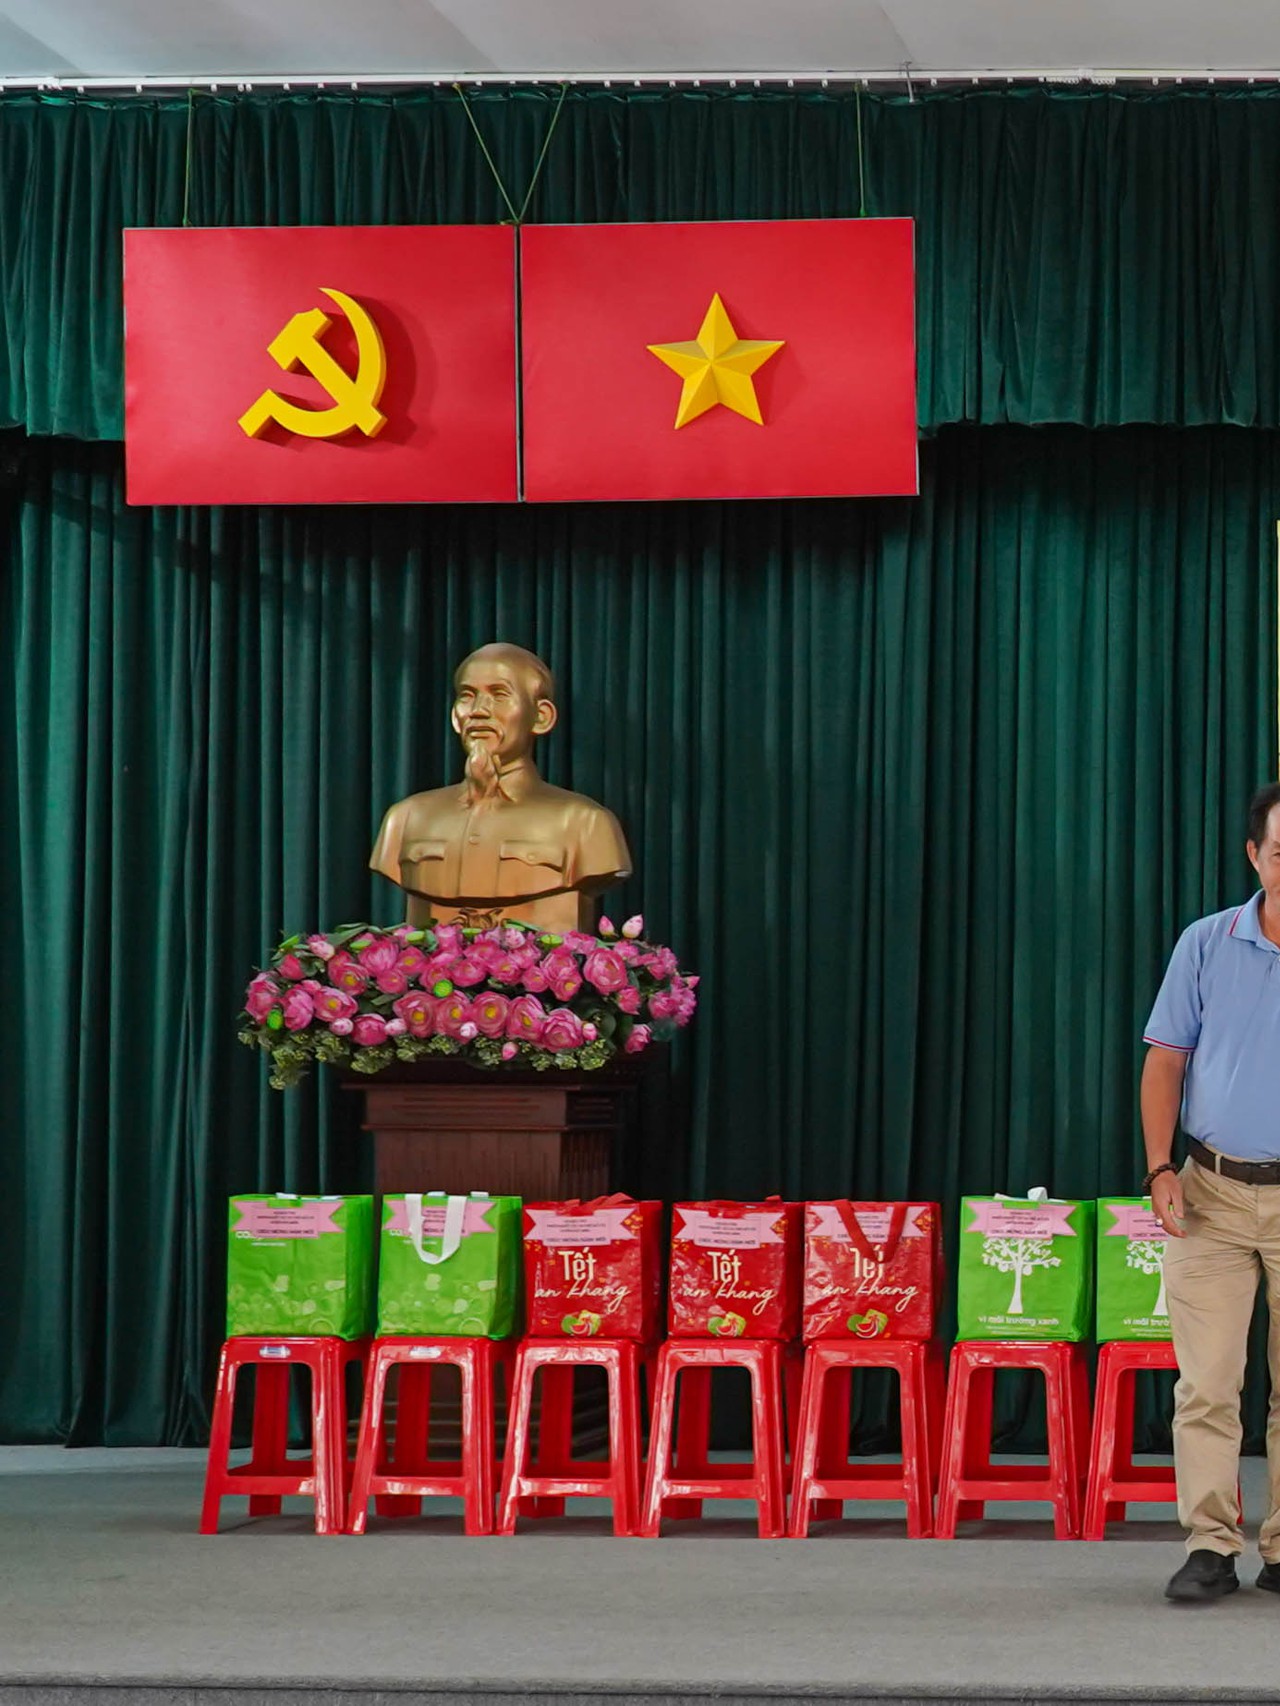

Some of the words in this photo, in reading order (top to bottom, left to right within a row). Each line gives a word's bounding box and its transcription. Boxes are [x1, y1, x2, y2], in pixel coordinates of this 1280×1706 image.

[557, 1246, 597, 1281] Tết
[707, 1249, 742, 1281] Tết
[534, 1286, 561, 1298] an
[566, 1280, 632, 1314] khang
[683, 1286, 710, 1298] an
[715, 1281, 778, 1316] khang
[856, 1279, 919, 1312] khang
